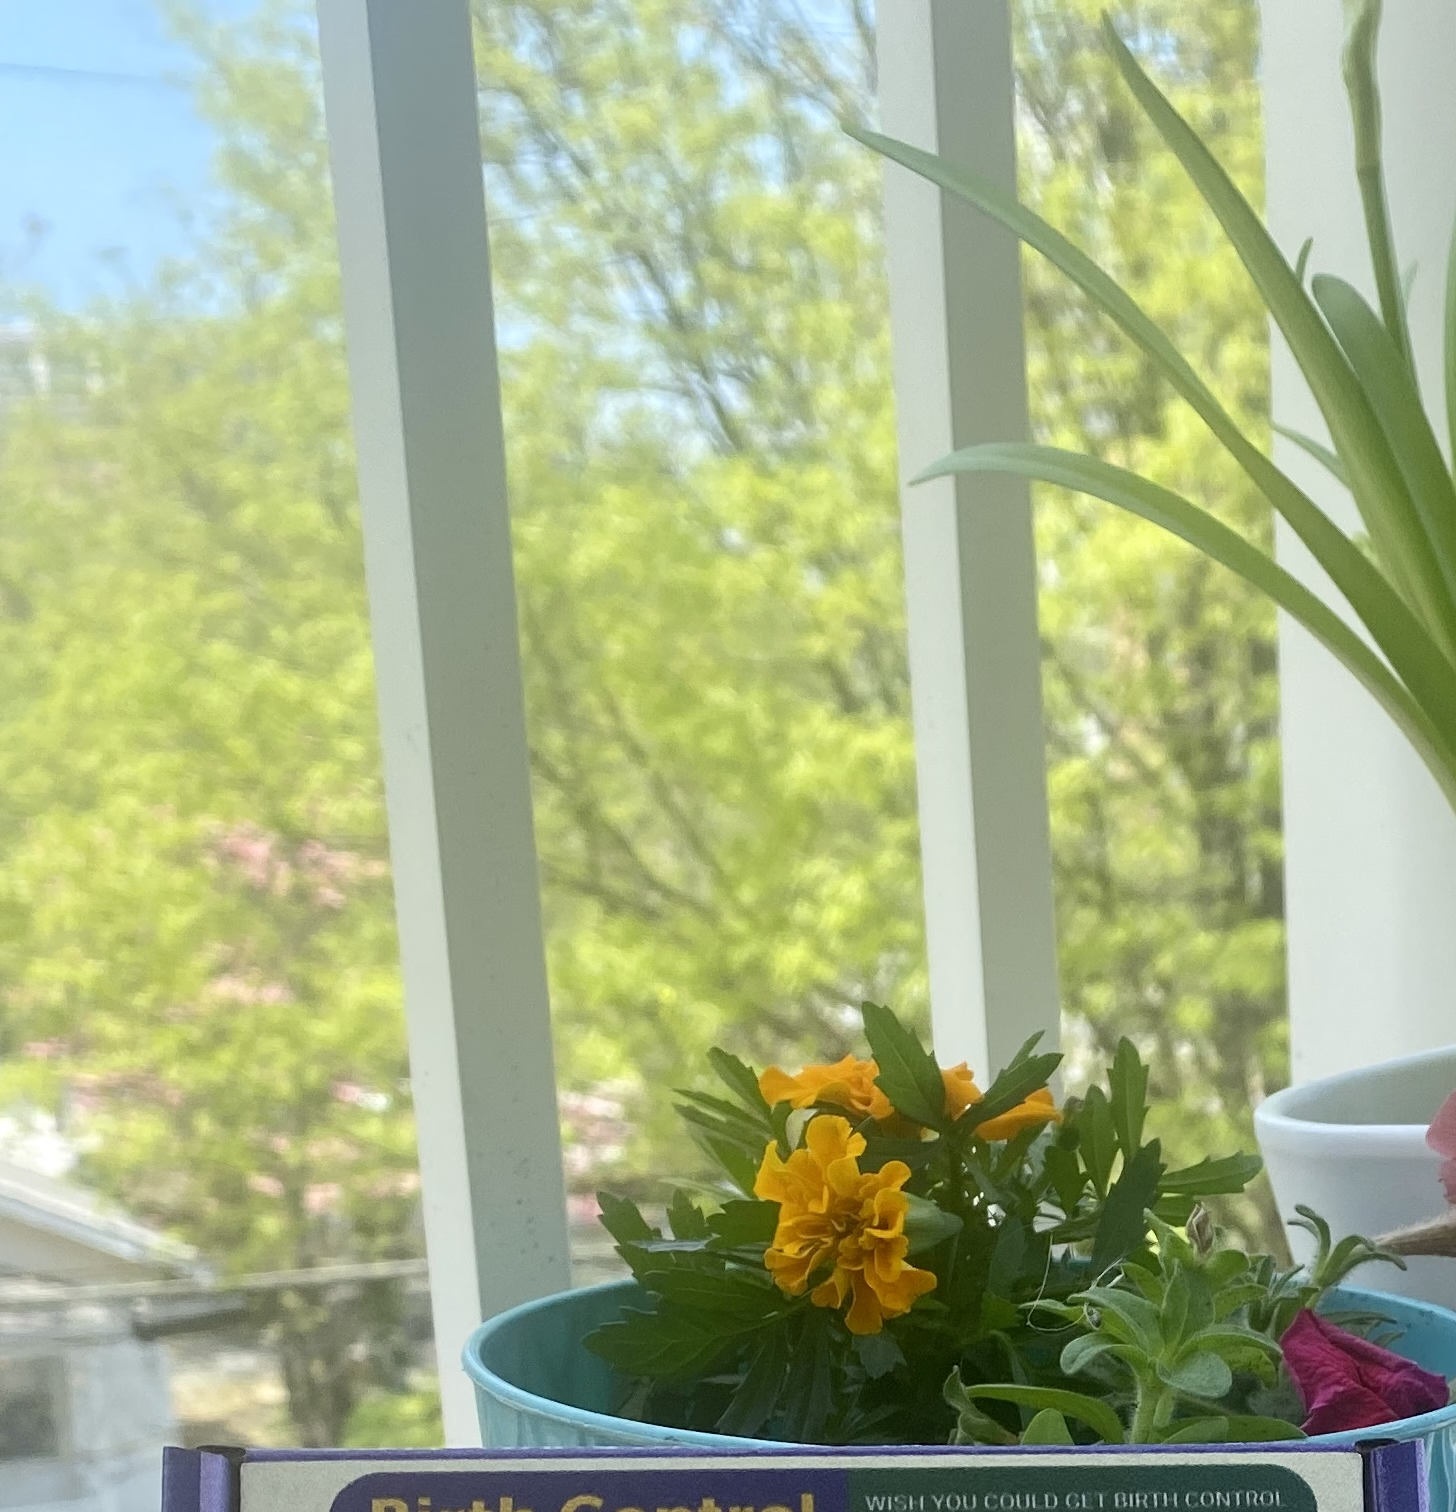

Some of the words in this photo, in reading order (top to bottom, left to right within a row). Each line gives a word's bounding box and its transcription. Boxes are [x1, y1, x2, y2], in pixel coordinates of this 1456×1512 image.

[864, 1493, 924, 1512] WISH
[931, 1493, 978, 1511] YOU
[983, 1492, 1058, 1511] COULD
[1064, 1491, 1107, 1510] GET
[1113, 1490, 1179, 1510] BIRTH
[1184, 1489, 1284, 1509] CONTROL
